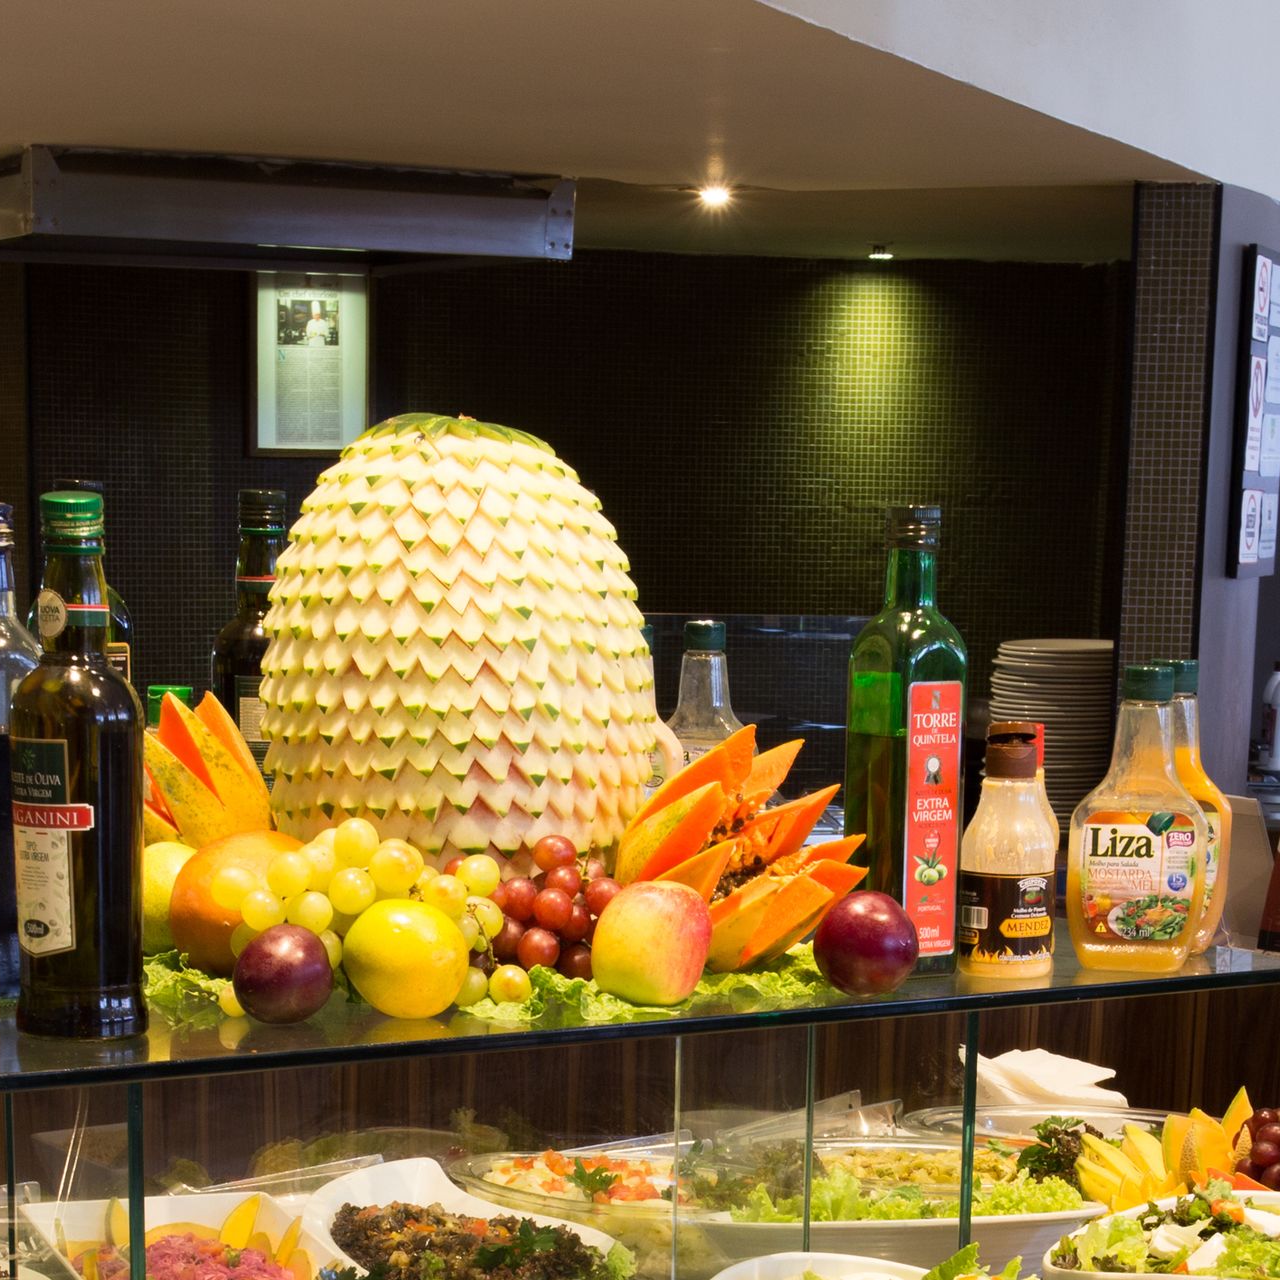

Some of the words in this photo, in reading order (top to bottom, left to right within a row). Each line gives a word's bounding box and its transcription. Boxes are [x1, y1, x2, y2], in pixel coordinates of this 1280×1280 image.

[913, 712, 957, 729] TORRE
[913, 733, 957, 747] QUINTELA
[34, 772, 62, 786] OLIVA
[916, 798, 949, 811] EXTRA
[913, 809, 953, 823] VIRGEM
[1168, 831, 1192, 841] ZERO
[1089, 827, 1154, 859] Liza
[1087, 868, 1153, 880] MOSTARDA
[1172, 873, 1183, 883] 15
[1131, 881, 1157, 891] MEL
[1006, 920, 1050, 932] MENDEZ
[1122, 927, 1136, 937] 234
[1138, 927, 1150, 937] ml
